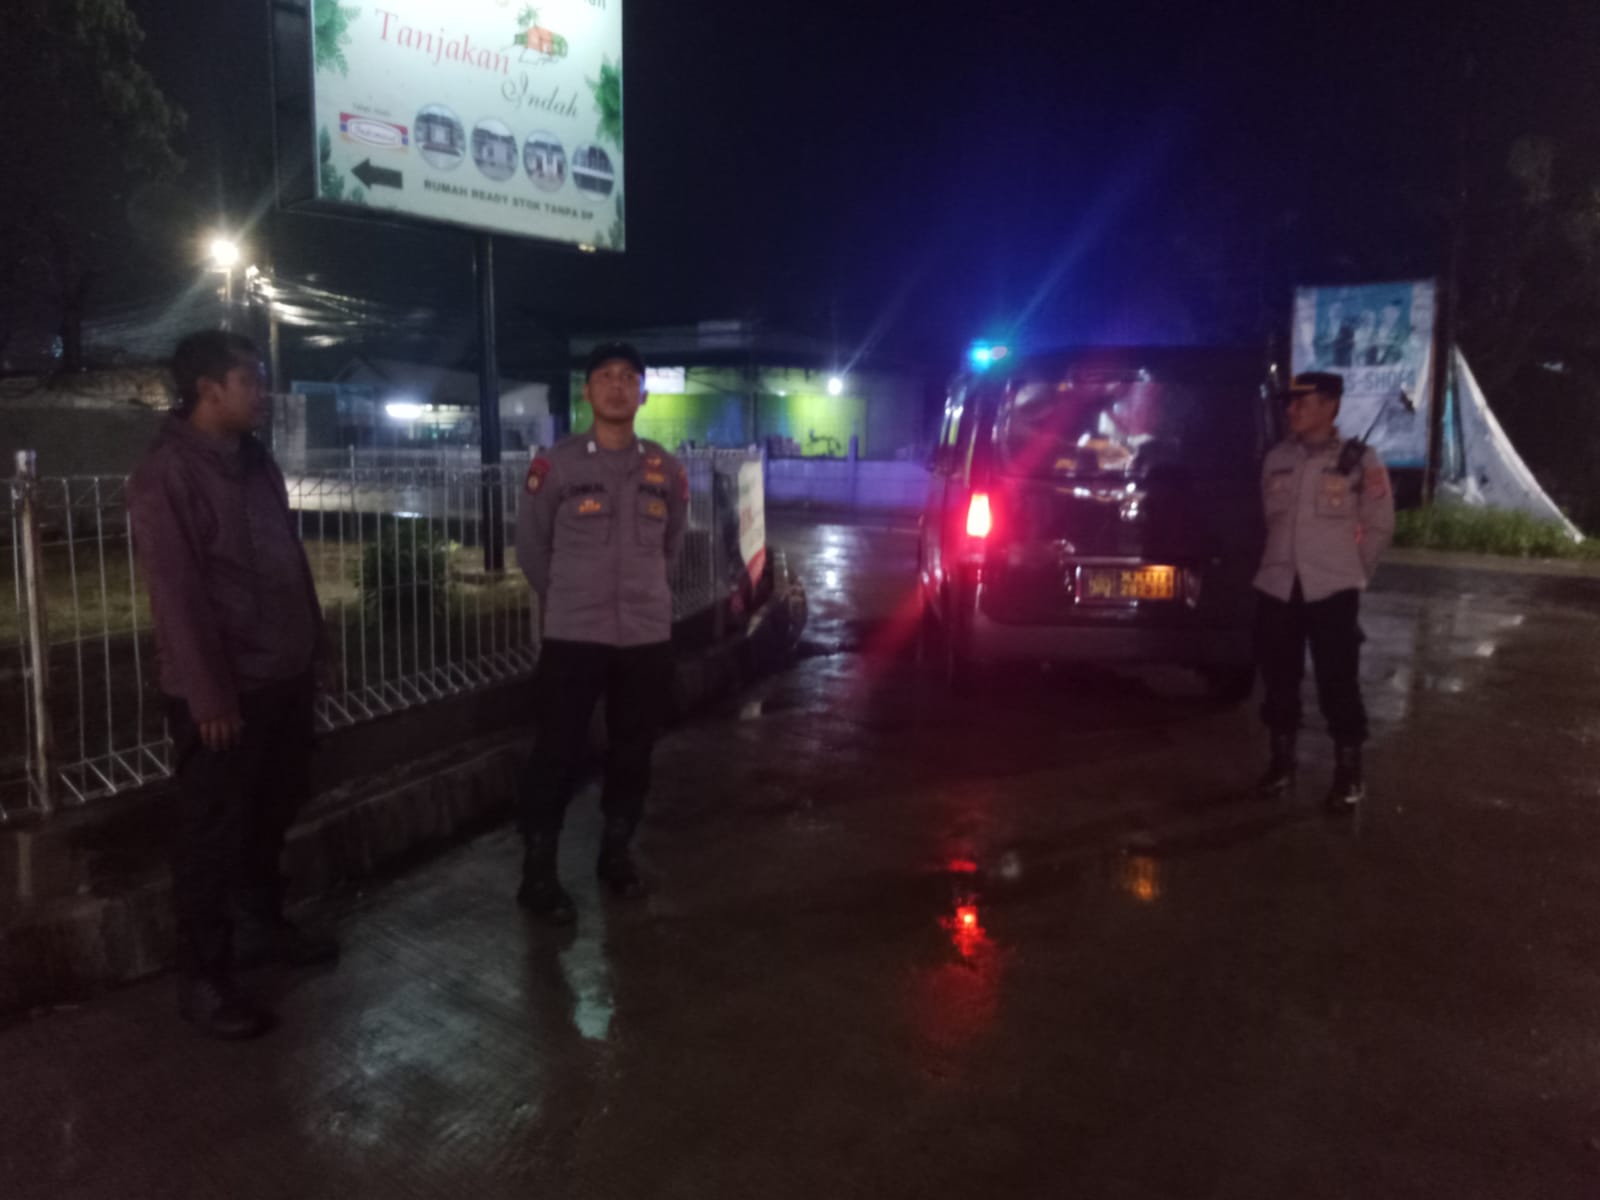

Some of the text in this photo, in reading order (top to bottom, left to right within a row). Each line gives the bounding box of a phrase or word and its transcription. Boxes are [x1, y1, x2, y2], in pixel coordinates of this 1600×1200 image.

[376, 9, 510, 74] Tanjakan
[502, 72, 579, 119] Indah
[424, 179, 468, 197] RUMAH
[471, 189, 509, 205] READY
[512, 197, 541, 211] STOK
[544, 203, 578, 218] TANPA
